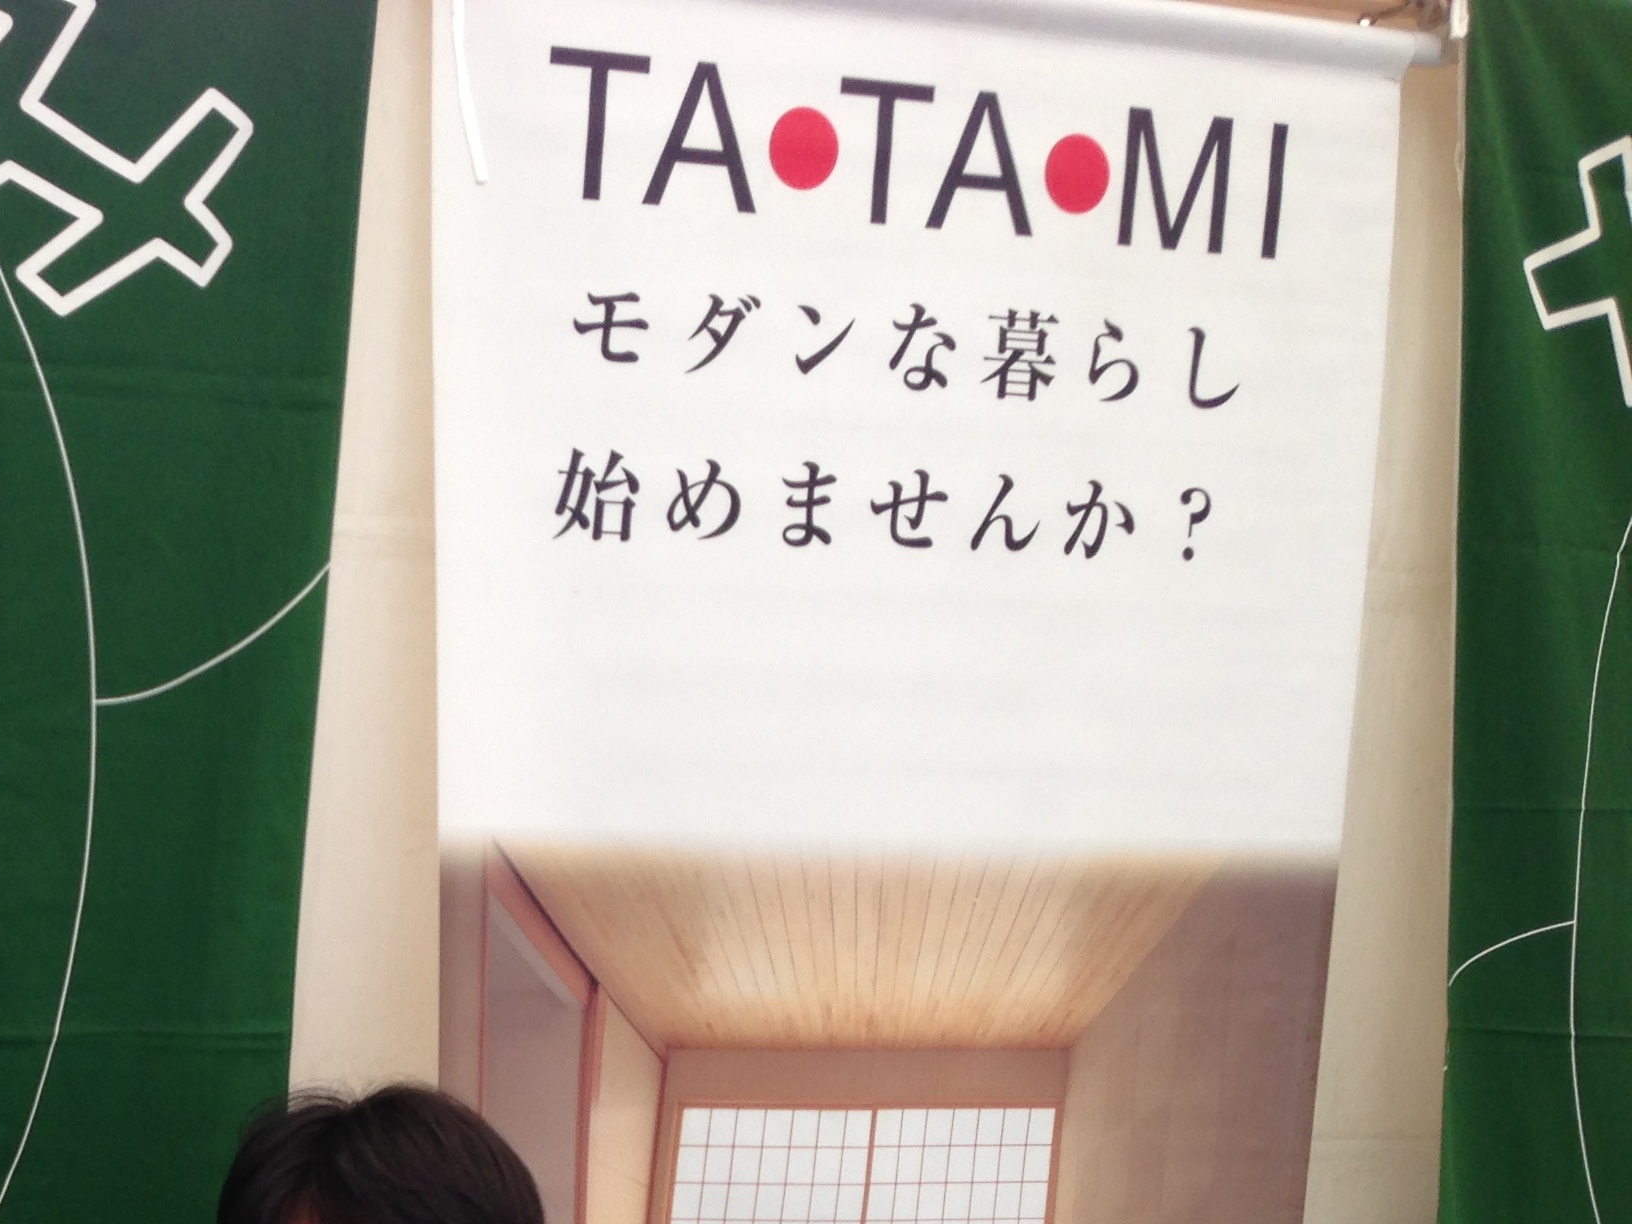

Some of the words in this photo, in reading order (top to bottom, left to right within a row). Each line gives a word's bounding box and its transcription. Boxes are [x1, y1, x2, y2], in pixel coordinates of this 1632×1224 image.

[572, 291, 1240, 411] モダンな暮らし
[552, 447, 1213, 562] 始めませんか？
